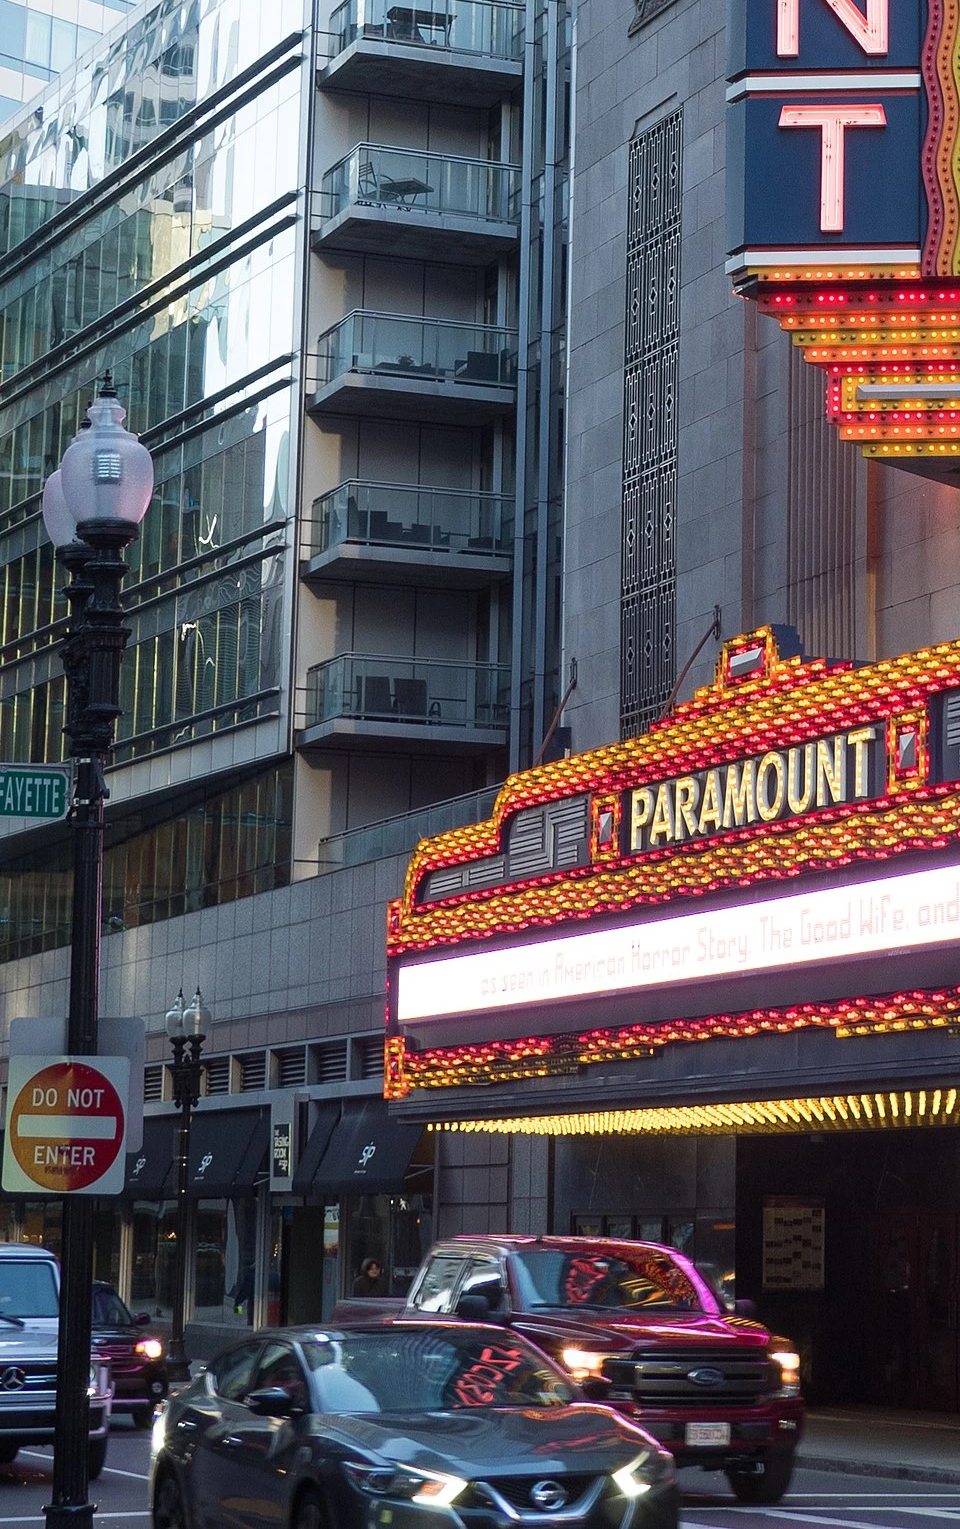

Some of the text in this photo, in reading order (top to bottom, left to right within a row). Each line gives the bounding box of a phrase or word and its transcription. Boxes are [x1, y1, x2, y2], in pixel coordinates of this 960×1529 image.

[630, 727, 877, 851] PARAMOUNT
[760, 916, 792, 952] The
[801, 901, 851, 945] Good
[918, 882, 960, 926] and
[32, 1088, 105, 1108] DO NOT
[34, 1145, 96, 1166] ENTER
